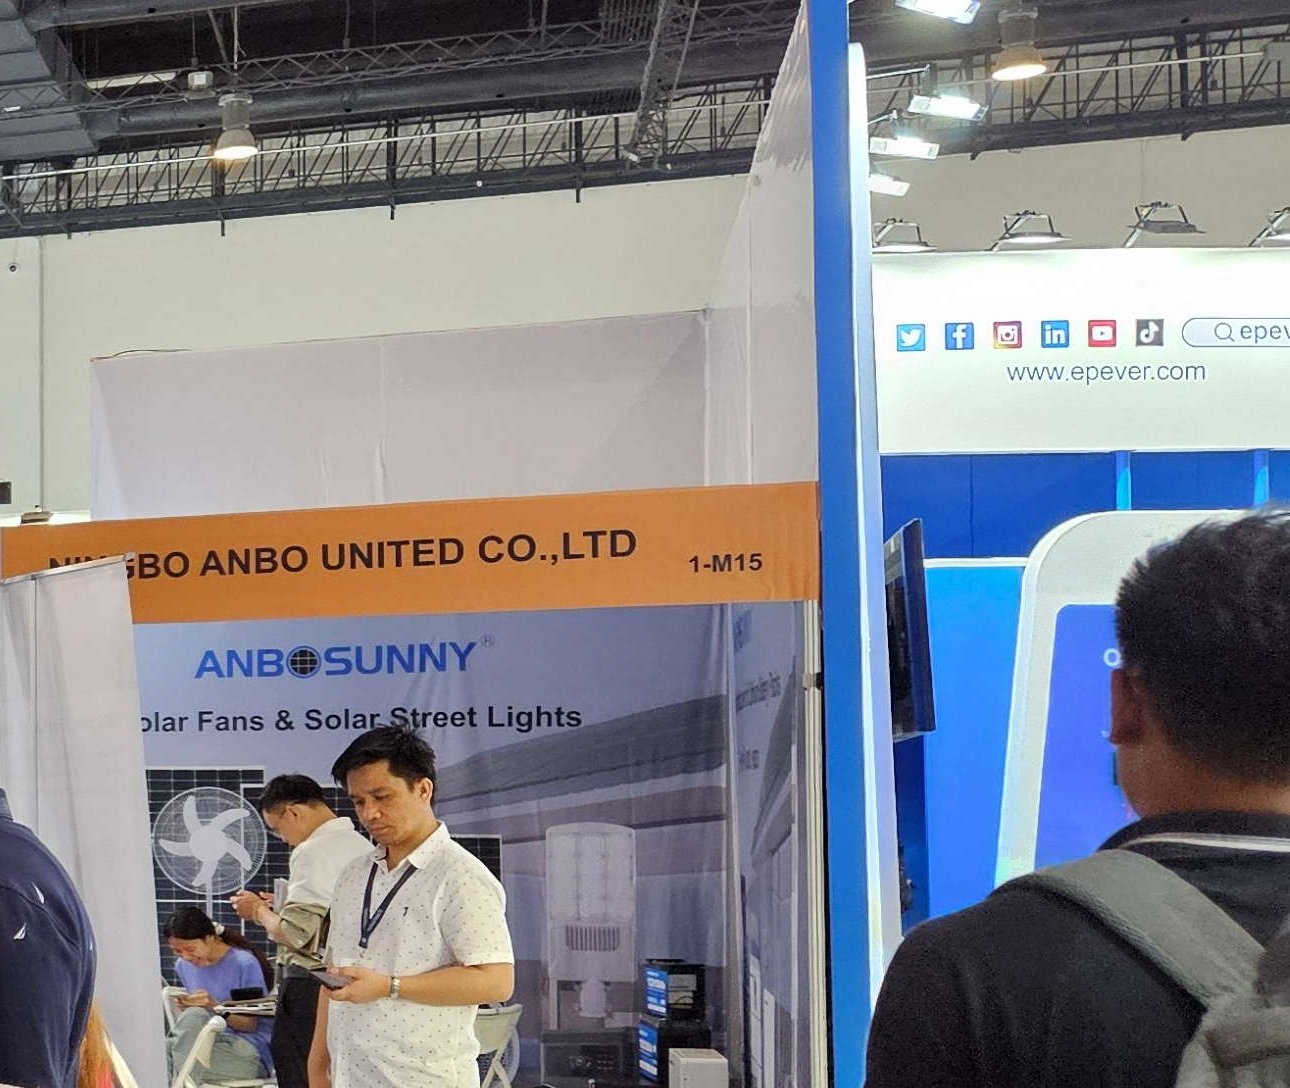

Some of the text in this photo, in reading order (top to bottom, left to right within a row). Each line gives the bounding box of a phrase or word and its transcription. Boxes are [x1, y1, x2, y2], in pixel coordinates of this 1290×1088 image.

[1007, 363, 1206, 386] www.epever.com
[199, 545, 309, 579] ANBO
[321, 538, 465, 572] UNITED
[477, 528, 638, 568] CO.,LTD
[689, 552, 764, 574] 1-M15
[194, 640, 478, 681] ANBOSUNNY
[198, 711, 264, 732] Fans
[276, 708, 295, 731] &
[304, 706, 380, 731] Solar
[391, 703, 477, 728] Street
[488, 704, 583, 735] Lights
